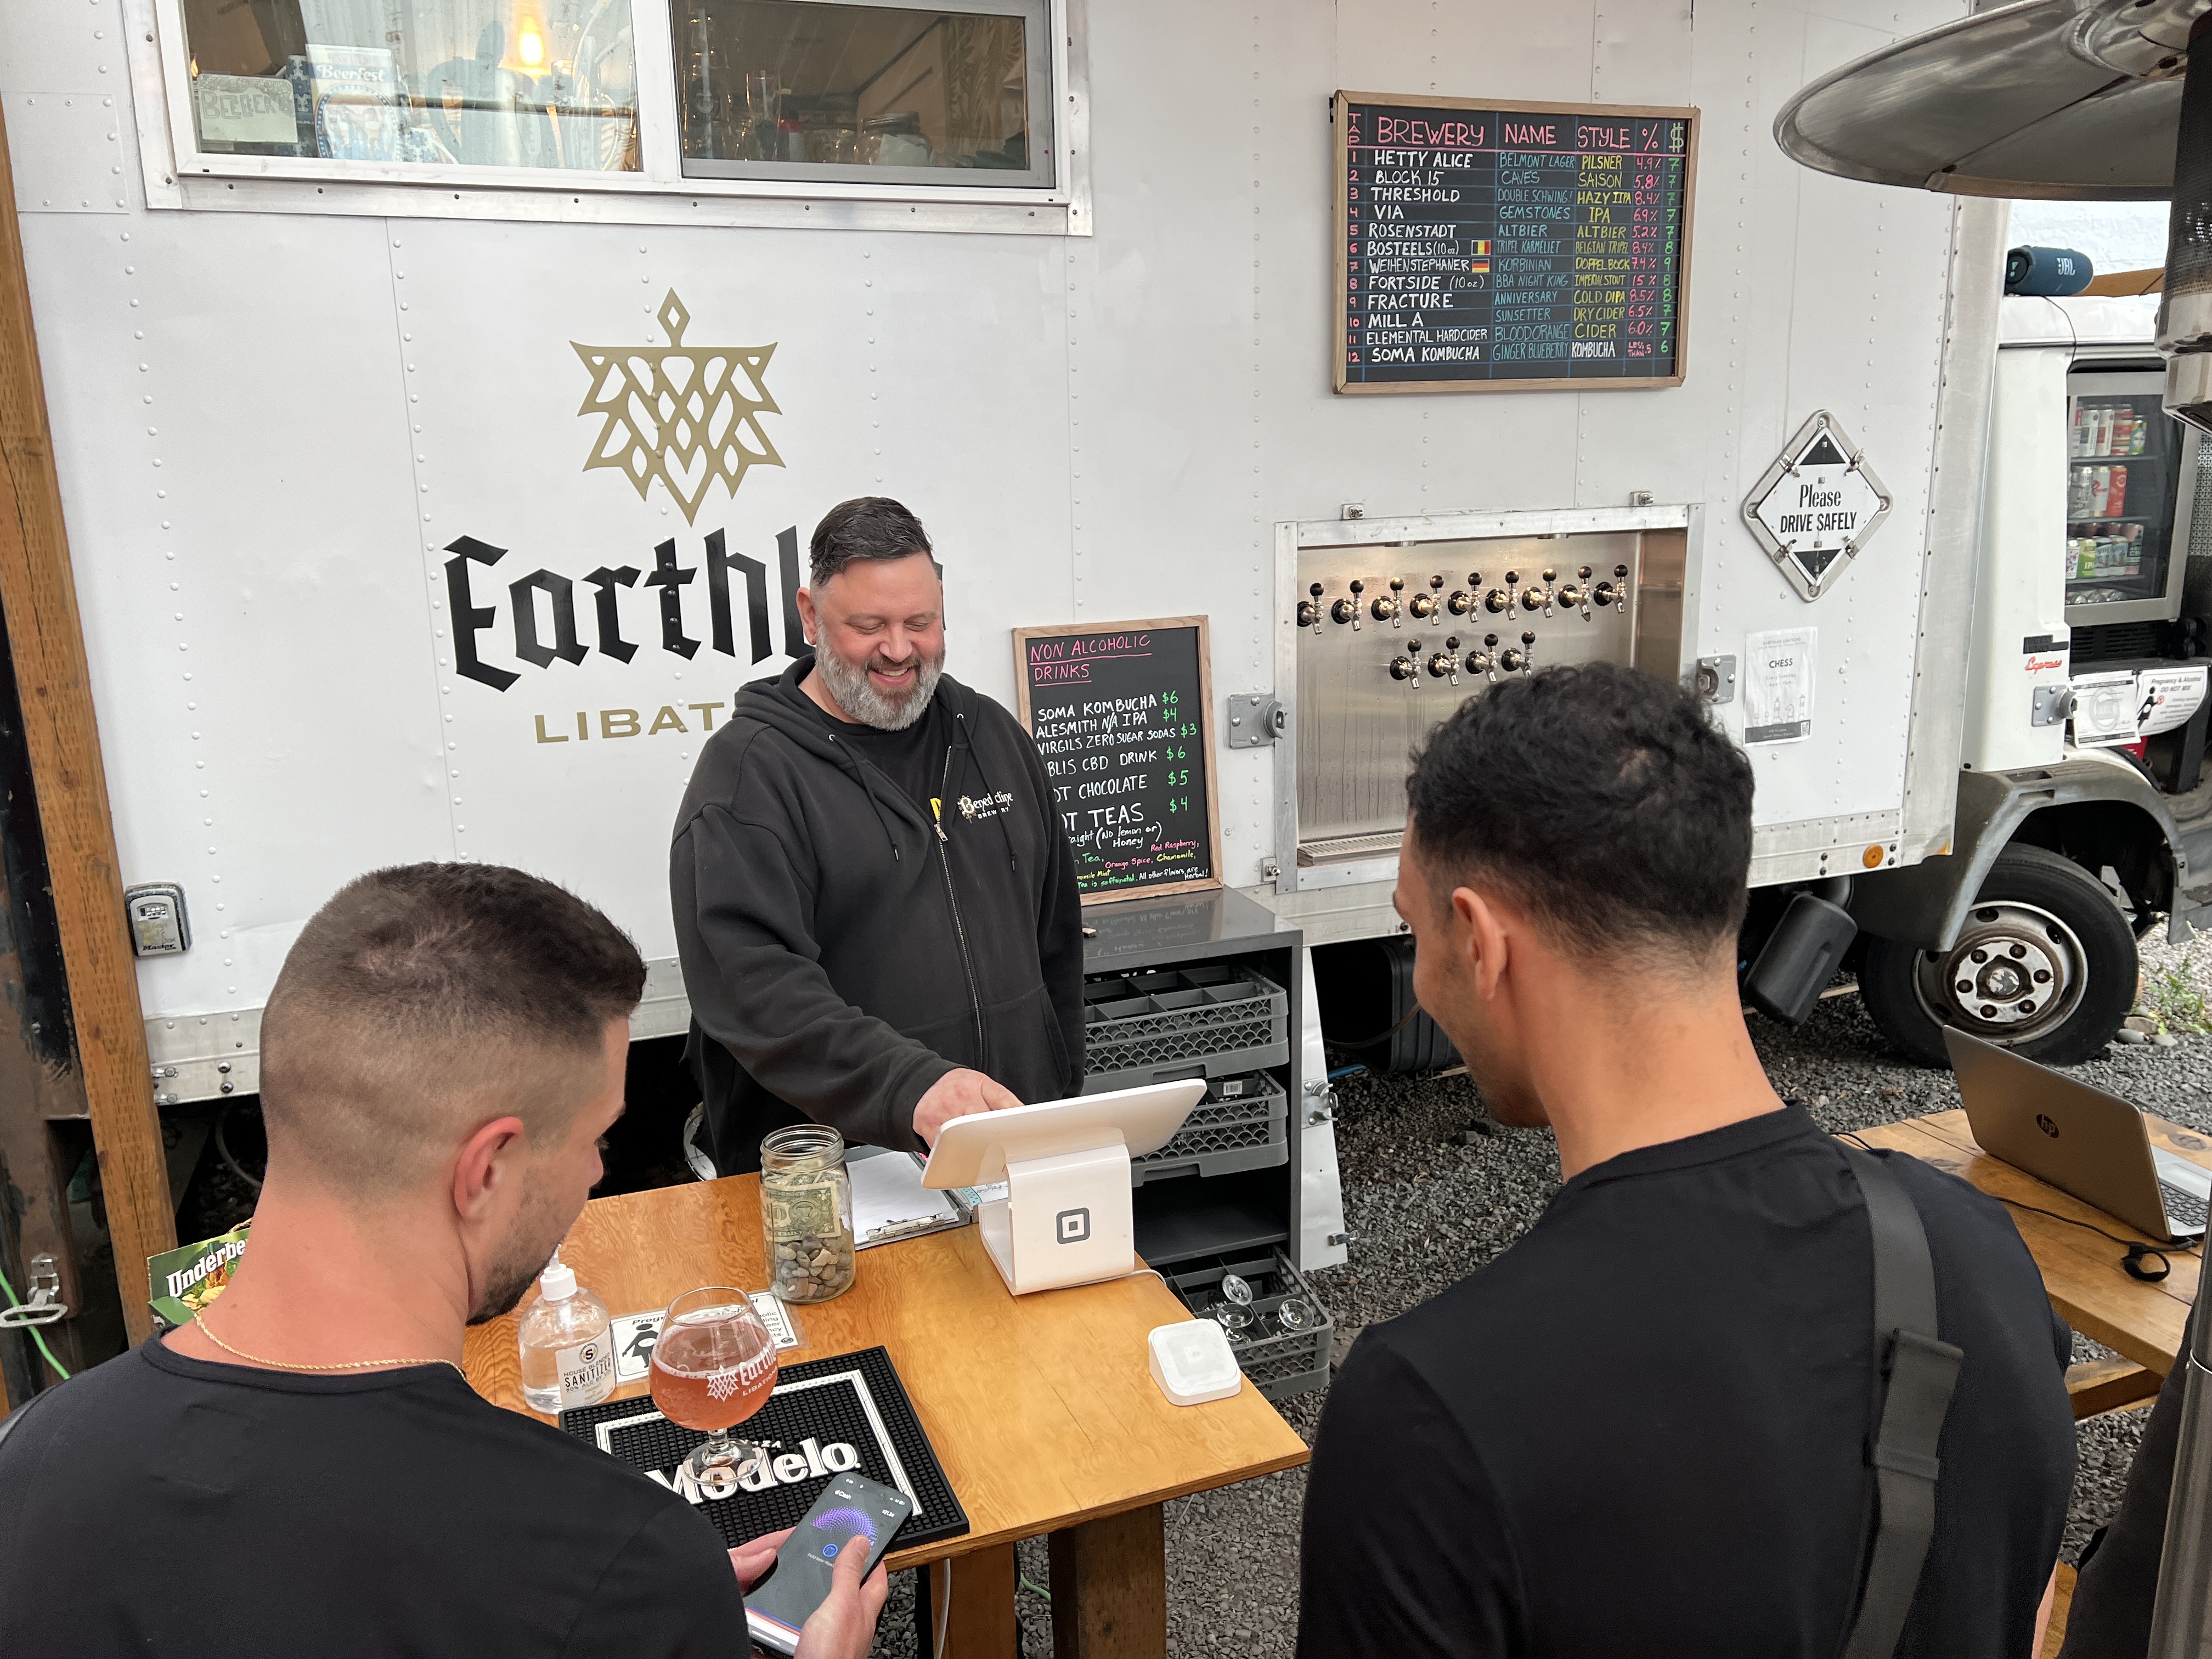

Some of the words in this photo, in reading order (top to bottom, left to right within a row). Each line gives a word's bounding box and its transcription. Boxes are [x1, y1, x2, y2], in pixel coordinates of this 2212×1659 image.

[317, 65, 386, 81] Beerfest
[1348, 112, 1361, 146] TAP
[1378, 116, 1484, 146] BREWERY
[1505, 123, 1556, 145] NAME
[1577, 126, 1631, 149] STYLE
[1641, 123, 1658, 151] %
[1669, 122, 1684, 153] $
[1374, 149, 1429, 167] HETTY
[1433, 152, 1474, 168] ALICE
[1500, 152, 1546, 168] BELMONT
[1548, 155, 1576, 169] LAGER
[1582, 155, 1622, 170] PILSNER
[1637, 157, 1661, 170] 4.9%
[1668, 157, 1679, 171] 7
[1350, 170, 1359, 181] 2
[1375, 170, 1421, 185] BLOCK
[1428, 171, 1444, 185] 15
[1501, 170, 1541, 185] CAVES
[1577, 172, 1622, 188] SAISON
[1668, 175, 1677, 187] 7
[1350, 187, 1359, 199] 3
[1370, 187, 1460, 202] THRESHOLD
[1498, 188, 1529, 202] DOUBLE
[1531, 189, 1573, 204] SCHWING!
[1577, 191, 1610, 205] HAZY
[1612, 191, 1632, 204] IIPA
[1634, 191, 1660, 205] 8.4%
[1667, 192, 1676, 206] 7
[1350, 207, 1358, 218] 4
[1374, 204, 1404, 219] VIA
[1499, 206, 1571, 220] GEMSTONES
[1589, 207, 1611, 224] IPA
[1667, 208, 1676, 222] 7
[1369, 222, 1457, 239] ROSENSTADT
[1498, 224, 1548, 238] ALTBIER
[1577, 225, 1627, 239] ALTBIER
[1632, 225, 1658, 239] 5.2%
[1665, 225, 1674, 240] 7
[1497, 240, 1518, 253] TRIPEL
[1522, 240, 1561, 253] KARMELIET
[1575, 241, 1605, 255] BELGIAN
[1608, 241, 1629, 255] TRIPEL
[1665, 241, 1673, 254] 8
[1369, 258, 1469, 274] WEIHENSTEPHANER
[1498, 258, 1551, 272] KORBINIAN
[1663, 257, 1672, 272] 9
[2057, 257, 2076, 275] JBL
[1369, 275, 1441, 290] FORTSIDE
[1496, 274, 1514, 288] BBA
[1517, 274, 1544, 287] NIGHT
[1546, 274, 1568, 287] KING
[1575, 274, 1602, 286] IMPERIAL
[1604, 274, 1626, 285] STOUT
[1663, 274, 1671, 286] 8
[1368, 292, 1454, 310] FRACTURE
[1494, 290, 1558, 305] ANNIVERSARY
[1574, 290, 1602, 303] COLD
[1605, 290, 1626, 303] DIPA
[1629, 289, 1655, 302] 8.5%
[1662, 289, 1672, 302] 8
[1350, 317, 1359, 327] 10
[1368, 313, 1407, 328] MILL
[1412, 312, 1424, 327] A
[1495, 308, 1551, 323] SUNSETTER
[1573, 307, 1594, 321] DRY
[1595, 306, 1626, 320] CIDER
[1628, 304, 1652, 318] 6.5%
[1663, 304, 1672, 317] 7
[1366, 329, 1434, 345] ELEMENTAL
[1575, 323, 1617, 339] CIDER
[1628, 321, 1653, 336] 6.0%
[1660, 321, 1671, 336] 7
[1348, 352, 1360, 362] 12
[1372, 347, 1415, 362] SOMA
[1421, 346, 1480, 362] KOMBUCHA
[1493, 342, 1526, 360] GINGER
[1528, 342, 1569, 360] BLUEBERRY
[1572, 341, 1616, 358] KOMBUCHA
[1661, 340, 1668, 353] 6
[1799, 484, 1841, 507] Please
[1780, 514, 1813, 533] DRIVE
[1817, 511, 1857, 532] SAFELY
[1031, 641, 1064, 662] NON
[1071, 635, 1151, 656] ALCOHOLIC
[1035, 663, 1090, 681] DRINKS
[1769, 658, 1793, 668] CHESS
[1038, 704, 1075, 722] SOMA
[1084, 693, 1158, 716] KOMBUCHA
[1162, 690, 1178, 704] $6
[534, 702, 725, 743] LIBAT
[1036, 719, 1097, 738] ALESMITH
[1102, 712, 1119, 734] N/A
[1122, 711, 1148, 727] IPA
[1163, 707, 1177, 722] $4
[1037, 737, 1082, 755] VIRGILS
[1086, 733, 1114, 749] ZERO
[1116, 730, 1143, 744] SUGAR
[1147, 727, 1176, 740] SODAS
[1181, 723, 1197, 738] $3
[1047, 759, 1077, 777] BLIS
[1082, 756, 1108, 771] CBD
[1120, 750, 1157, 766] DRINK
[1079, 774, 1147, 799] CHOCOLATE
[957, 791, 1013, 815] Benedctine
[977, 806, 1009, 819] BREWRY
[1087, 802, 1144, 827] TEAS
[1118, 826, 1142, 837] lemon
[1113, 837, 1143, 849] Honey
[1082, 852, 1104, 864] Tea,
[1105, 861, 1129, 870] Orange
[1131, 857, 1153, 867] Spice,
[1097, 869, 1111, 877] Mint
[1139, 871, 1147, 881] All
[1148, 870, 1164, 879] other
[2040, 1115, 2057, 1137] hp
[166, 1239, 249, 1297] Underbe
[563, 1367, 586, 1377] HOUSE
[565, 1357, 611, 1387] SANITIZER
[582, 1380, 594, 1389] ALC
